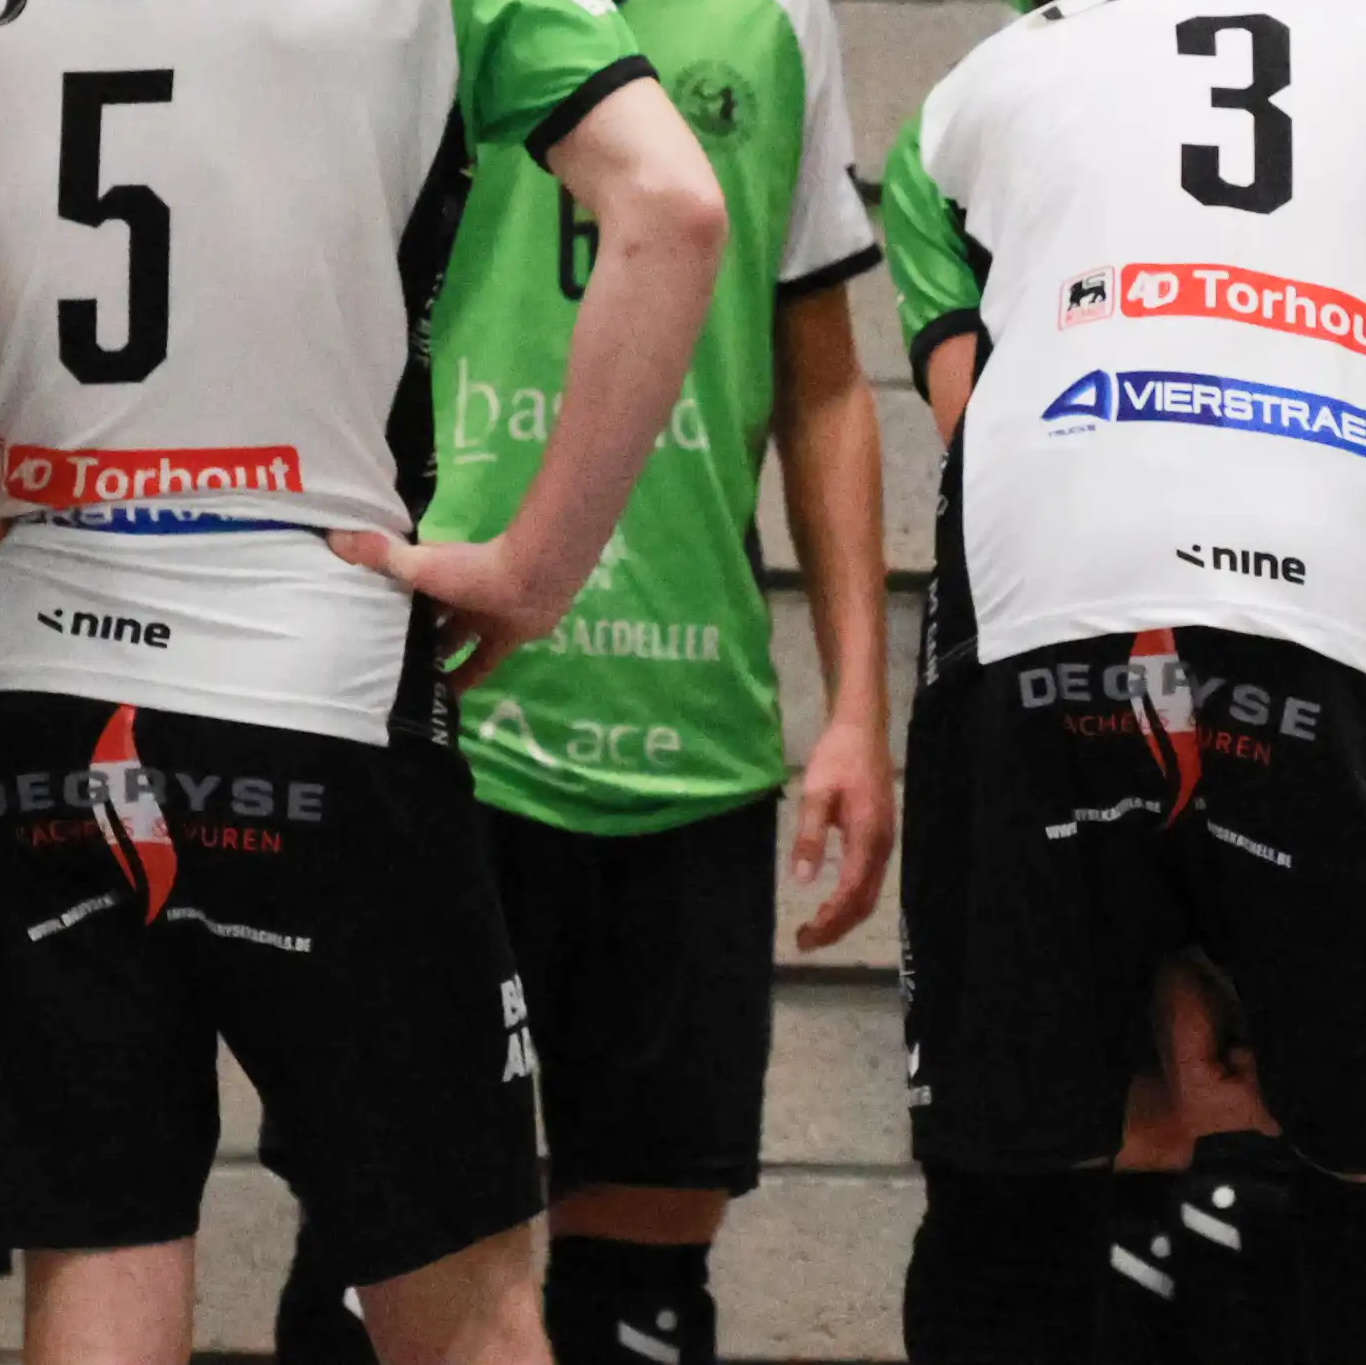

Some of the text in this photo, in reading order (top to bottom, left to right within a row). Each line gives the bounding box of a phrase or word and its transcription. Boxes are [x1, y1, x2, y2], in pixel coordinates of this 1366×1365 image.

[1175, 13, 1293, 215] 3
[57, 69, 174, 384] 5
[1127, 270, 1180, 309] AD
[67, 456, 291, 501] Torhout
[1212, 544, 1306, 586] nine
[71, 611, 172, 649] nine
[566, 717, 681, 766] ace
